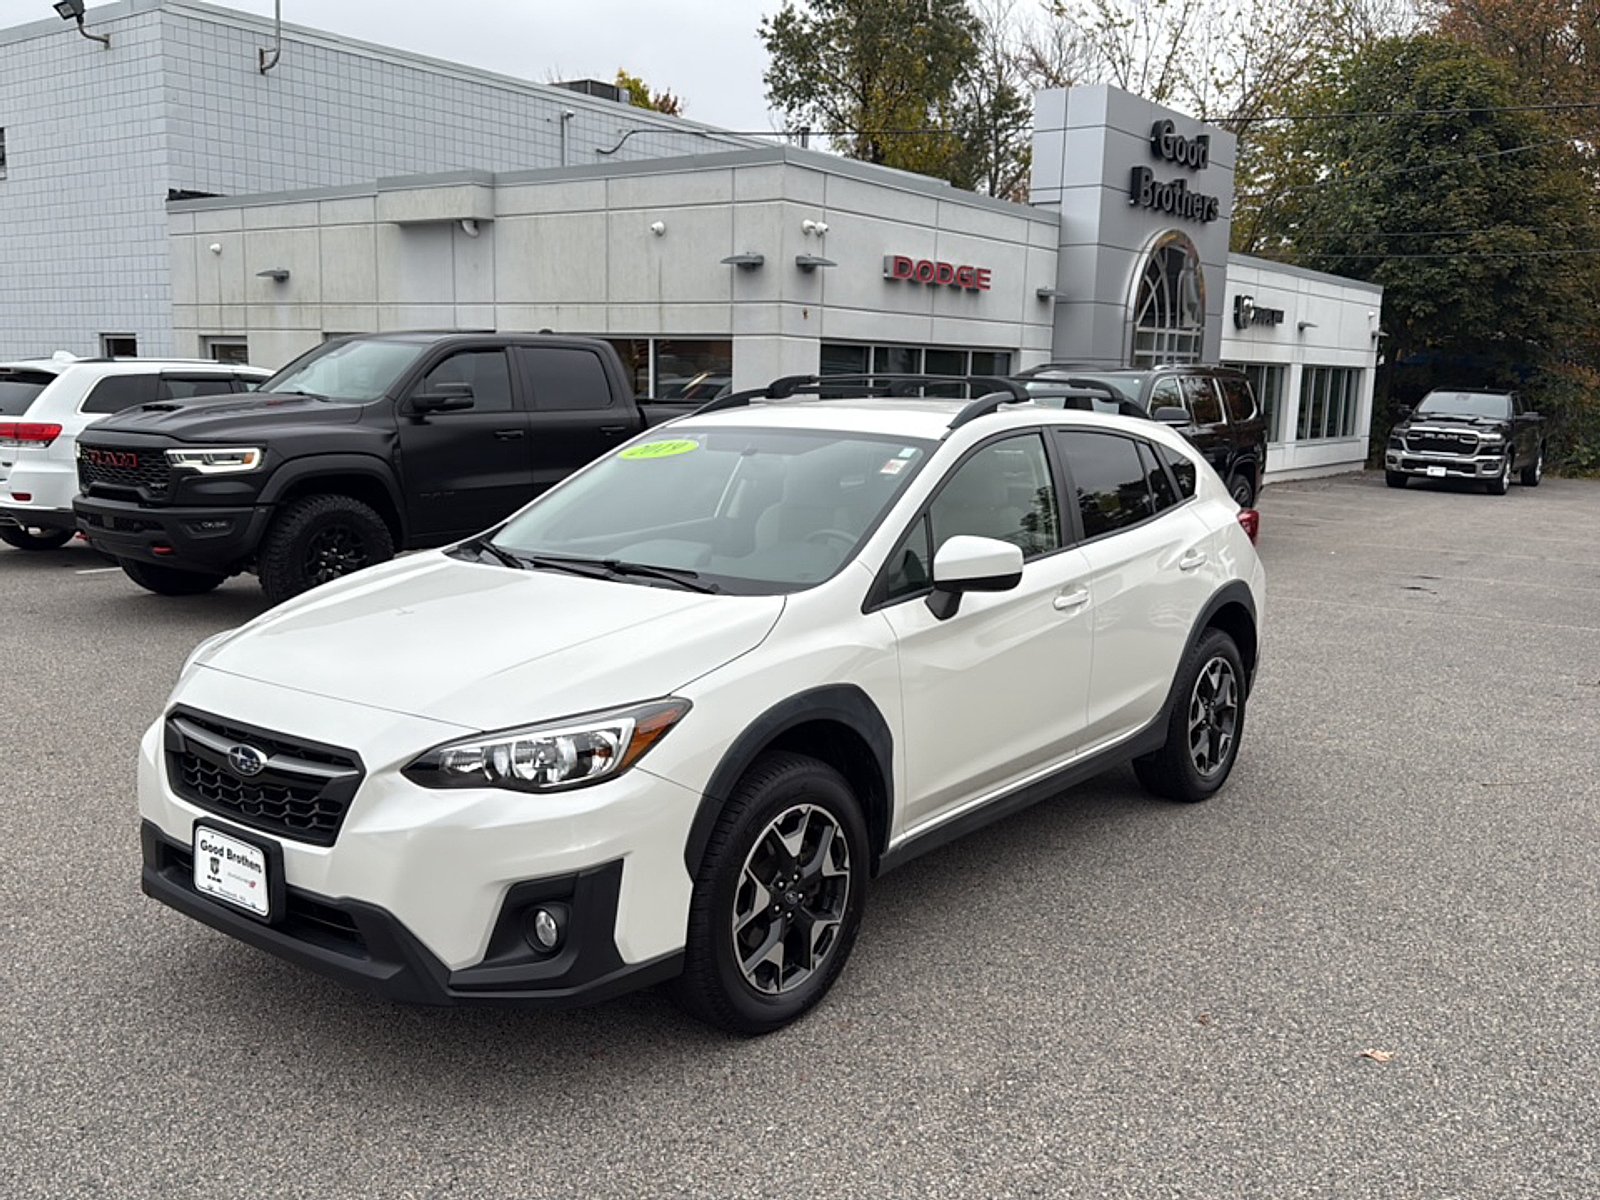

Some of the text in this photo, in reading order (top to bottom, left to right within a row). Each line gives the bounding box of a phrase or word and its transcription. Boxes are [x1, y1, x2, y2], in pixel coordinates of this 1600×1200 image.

[1151, 119, 1209, 169] Good
[1130, 166, 1219, 221] Brothers
[889, 255, 992, 291] DODGE
[626, 441, 690, 457] 2019
[1424, 432, 1459, 442] RAM
[87, 448, 138, 468] RAM
[200, 839, 262, 874] Good Brothers
